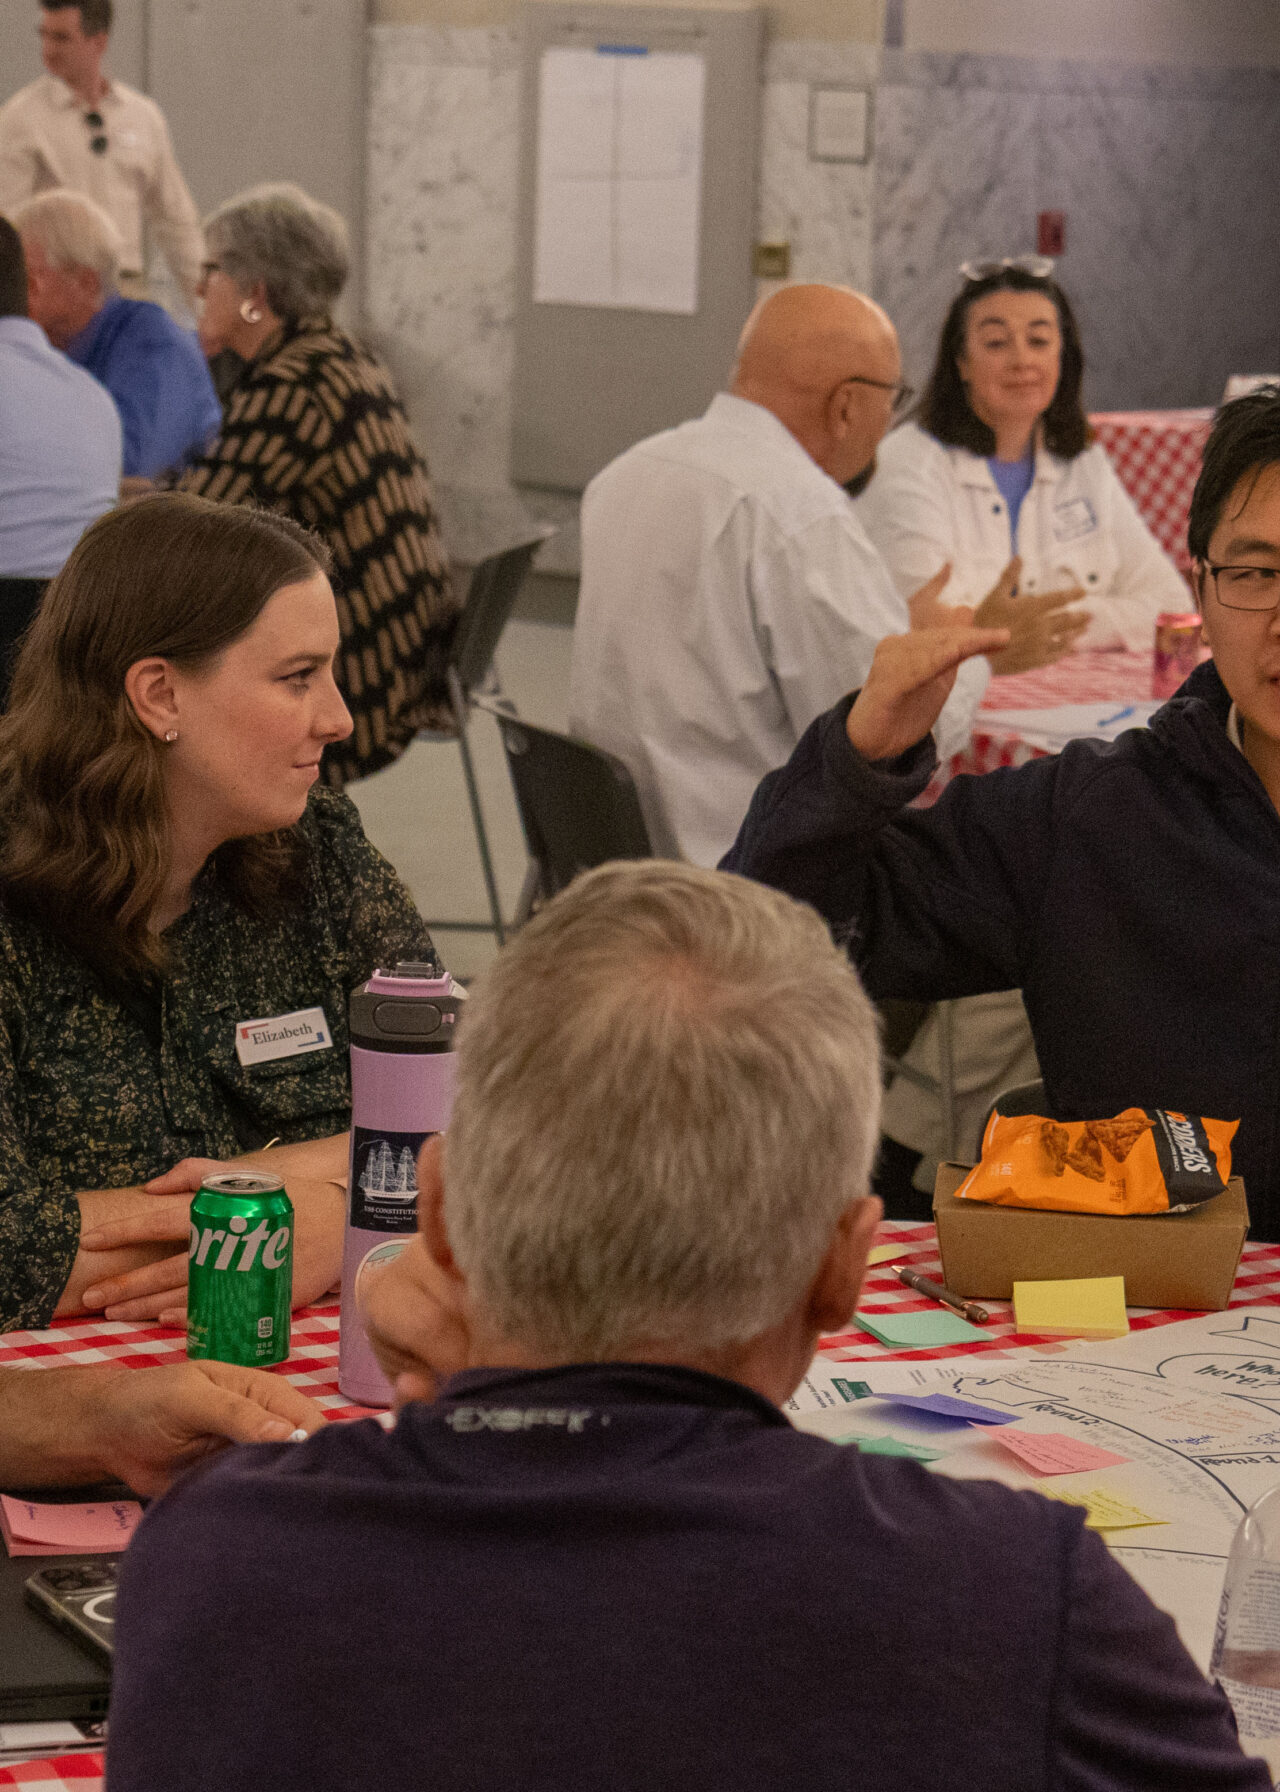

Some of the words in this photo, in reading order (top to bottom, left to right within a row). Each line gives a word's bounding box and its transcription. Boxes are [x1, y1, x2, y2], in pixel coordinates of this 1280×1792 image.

[252, 1022, 313, 1046] Elizabeth
[376, 1207, 420, 1215] CONSTITUTIO
[1030, 1402, 1080, 1423] Round
[1200, 1456, 1261, 1467] Round
